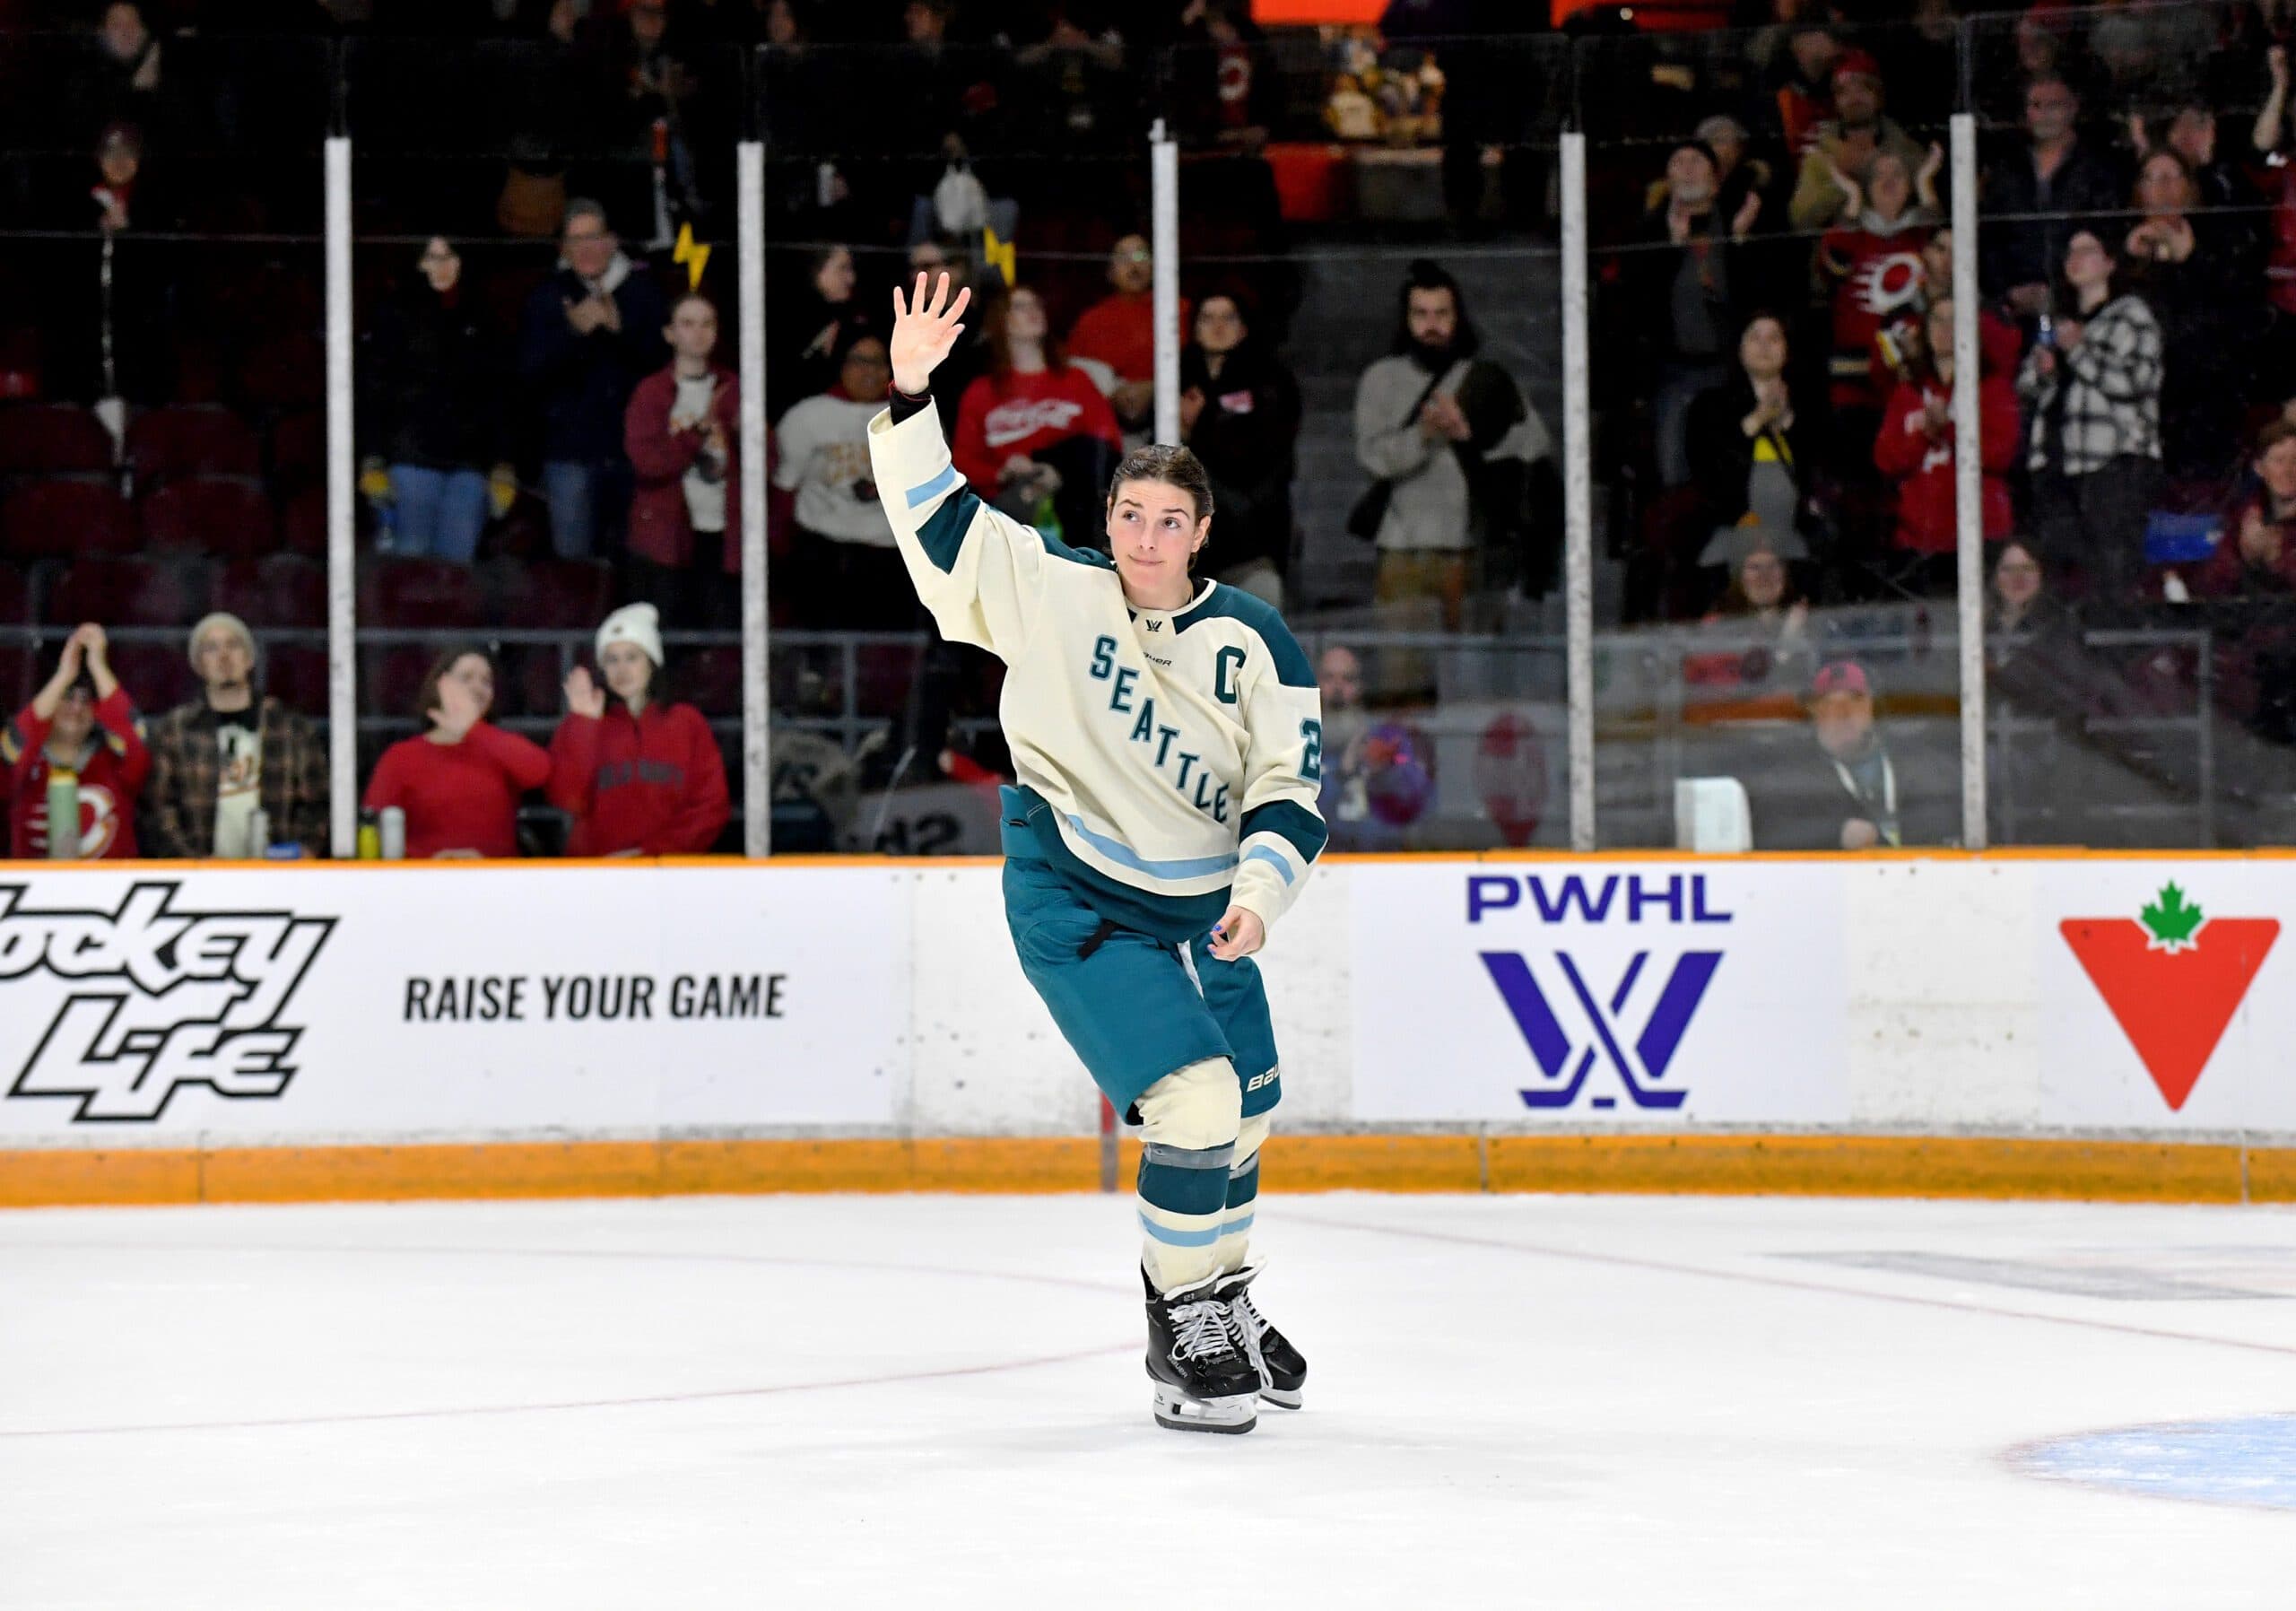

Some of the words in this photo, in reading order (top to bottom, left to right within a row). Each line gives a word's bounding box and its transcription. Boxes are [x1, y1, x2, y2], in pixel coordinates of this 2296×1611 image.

[1214, 644, 1247, 704] C
[1089, 633, 1230, 823] SEATTLE
[1465, 874, 1735, 923] PWHL
[0, 881, 340, 1032] ockey
[404, 976, 527, 1022] RAISE
[542, 975, 656, 1021] YOUR
[669, 973, 787, 1020] GAME
